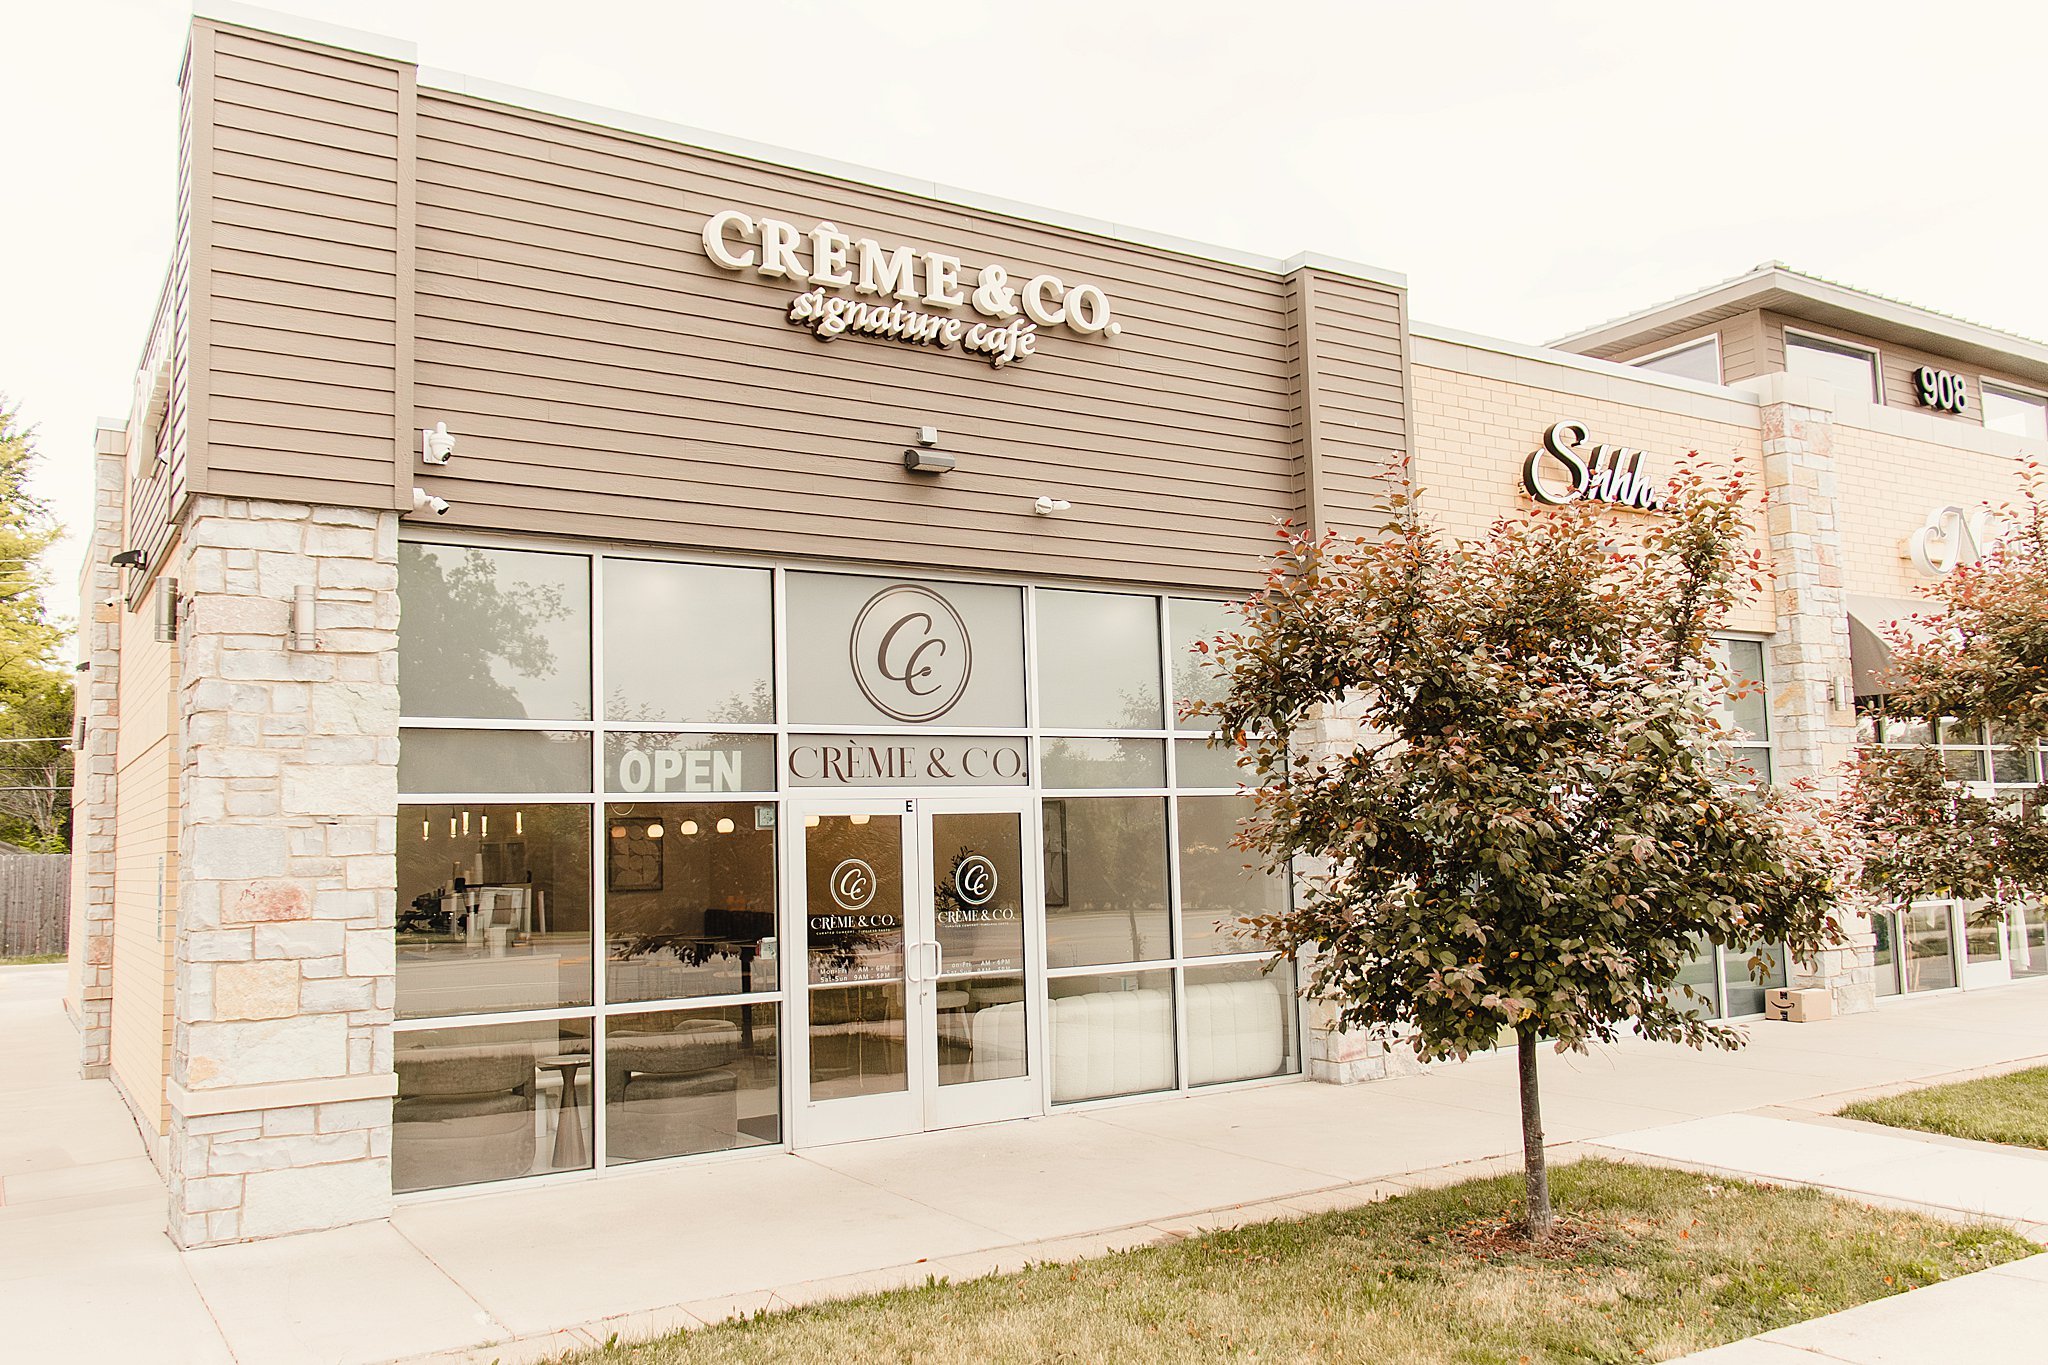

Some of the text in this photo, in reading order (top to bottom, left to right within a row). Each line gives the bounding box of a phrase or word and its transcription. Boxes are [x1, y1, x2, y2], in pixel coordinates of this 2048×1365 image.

[702, 210, 964, 309] CRÊME
[788, 287, 1037, 368] signature café
[1915, 365, 1968, 413] 908
[619, 749, 742, 792] OPEN
[788, 739, 1027, 783] CRÈME & CO.
[906, 800, 913, 812] E
[810, 914, 896, 930] CRÈME & CO.
[937, 908, 1015, 923] CRÈME & CO.
[820, 967, 847, 975] Mon-Fri
[820, 975, 847, 983] Sat-Sun
